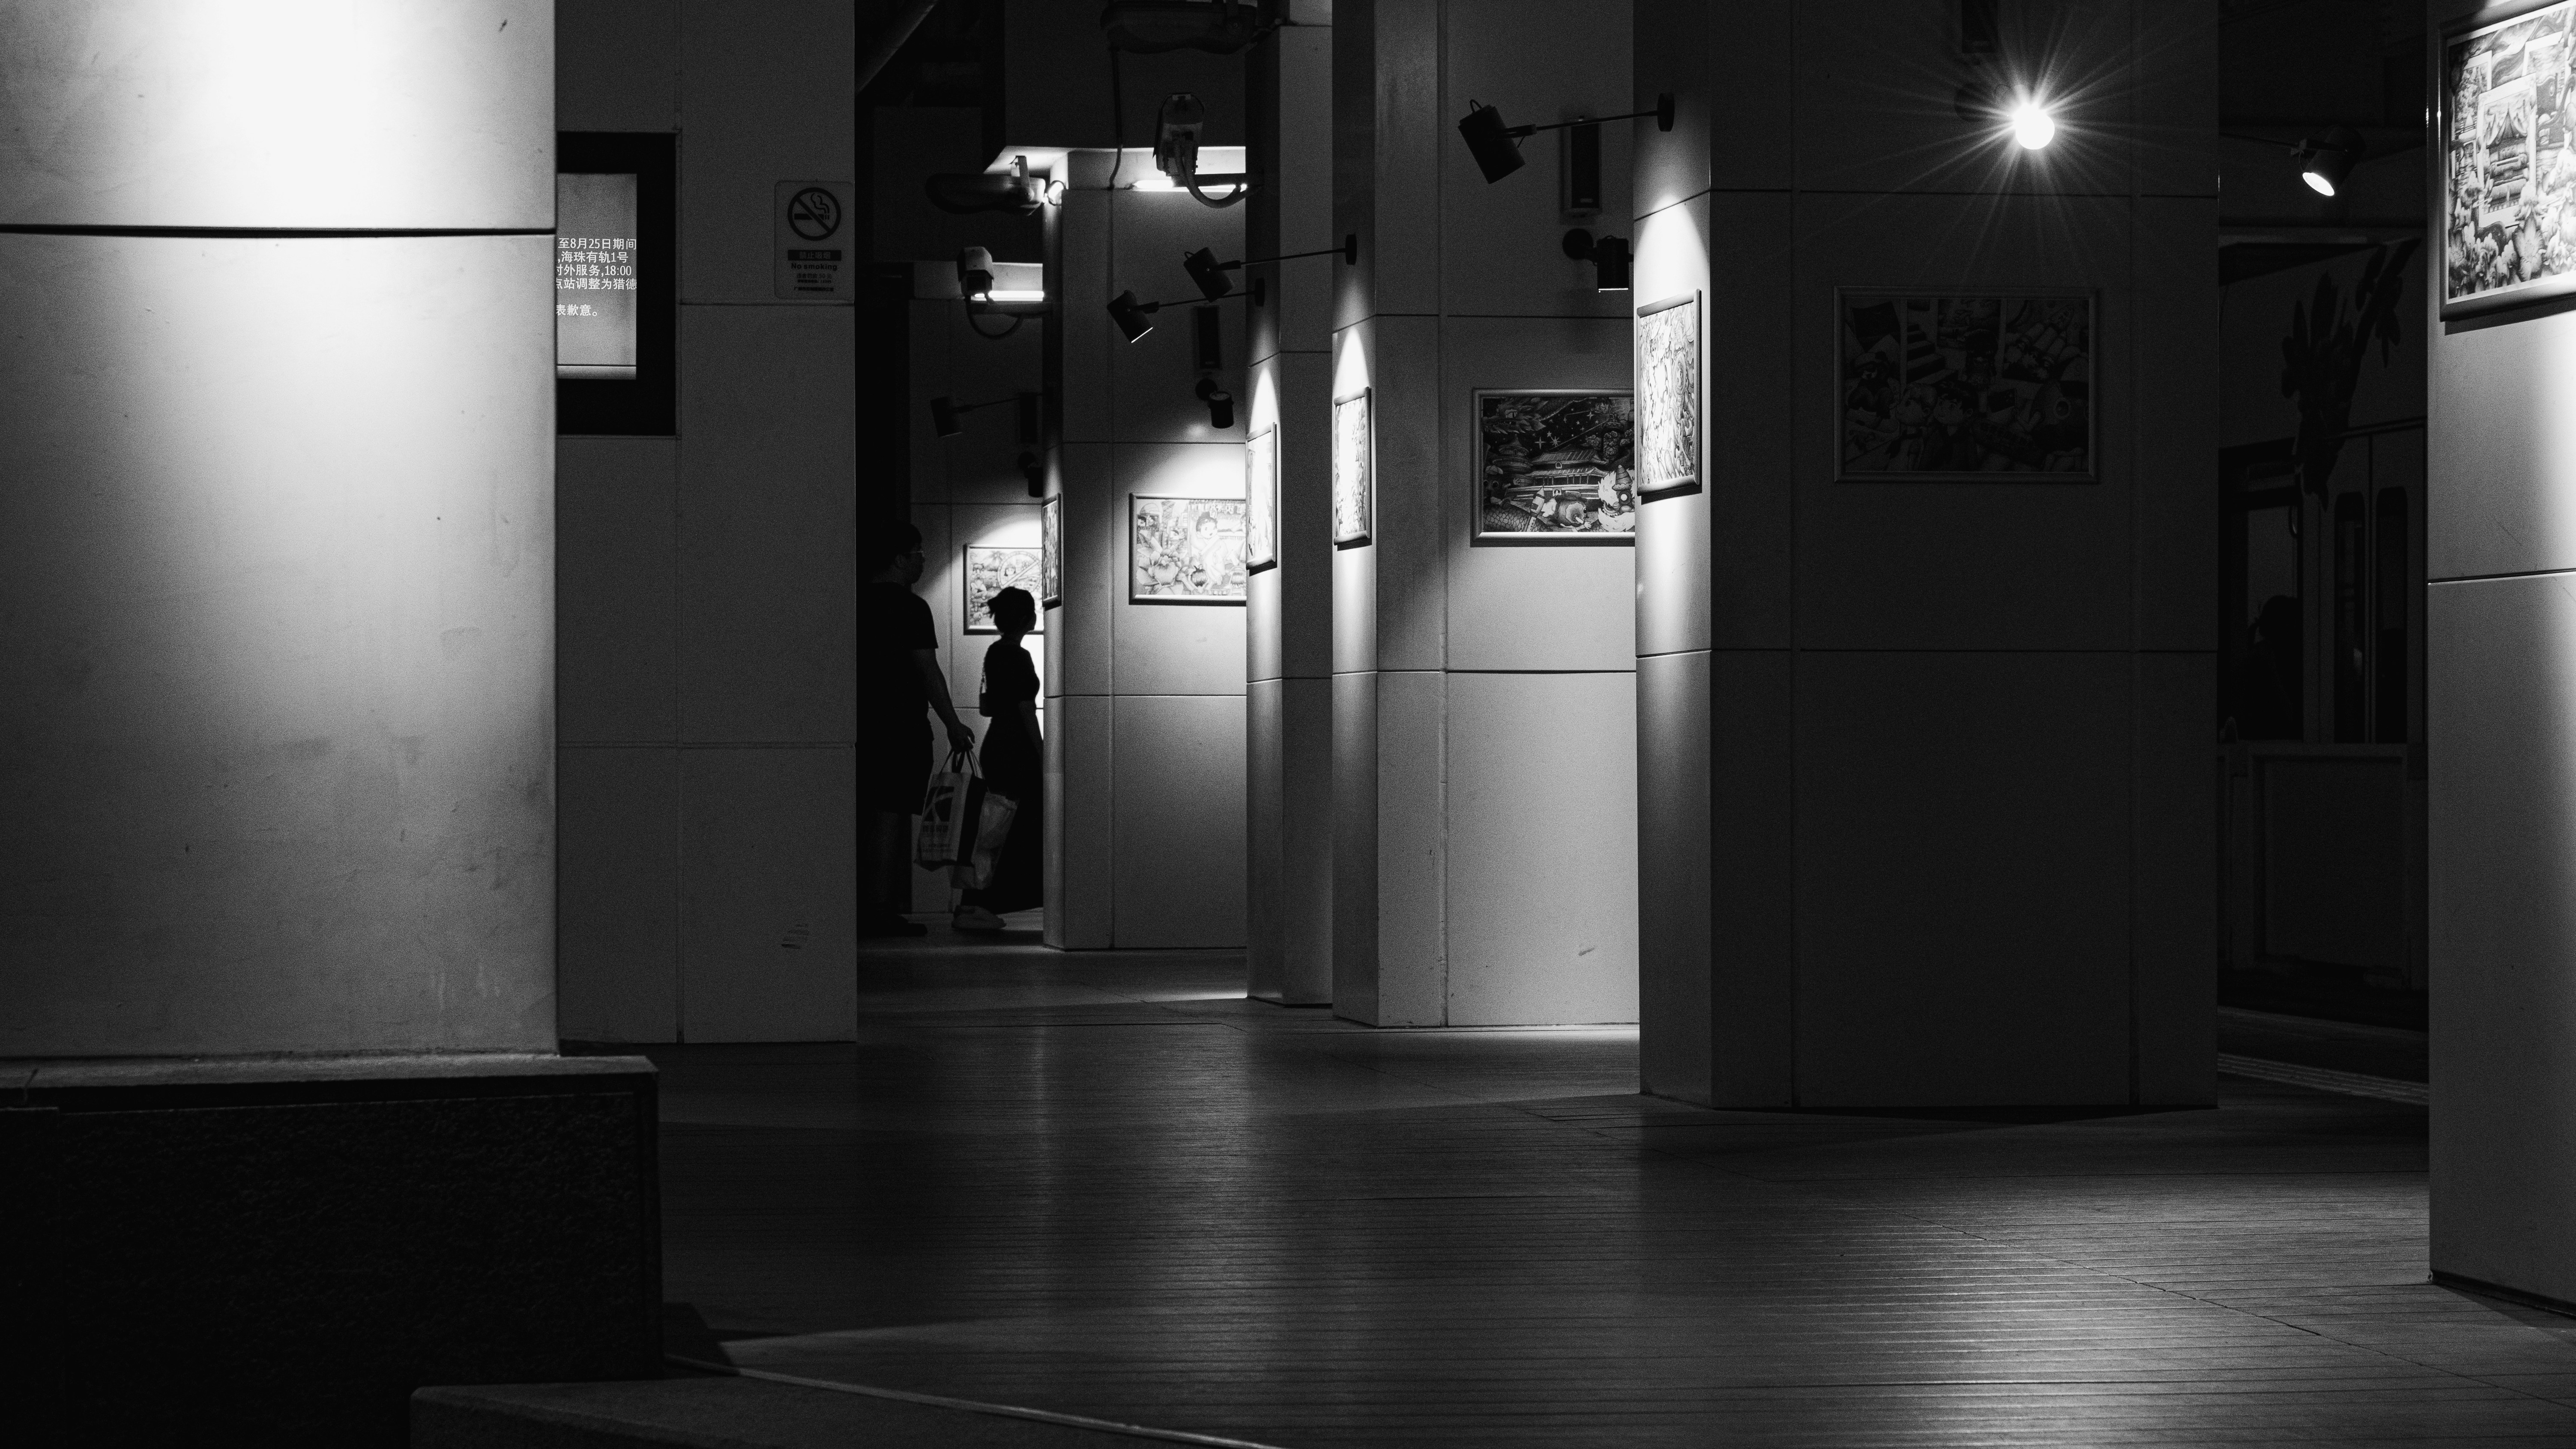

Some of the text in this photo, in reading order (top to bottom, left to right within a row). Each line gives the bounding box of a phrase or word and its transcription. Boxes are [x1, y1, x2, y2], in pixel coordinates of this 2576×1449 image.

[558, 238, 637, 250] 至8月25日期间
[799, 251, 831, 259] 禁止吸烟
